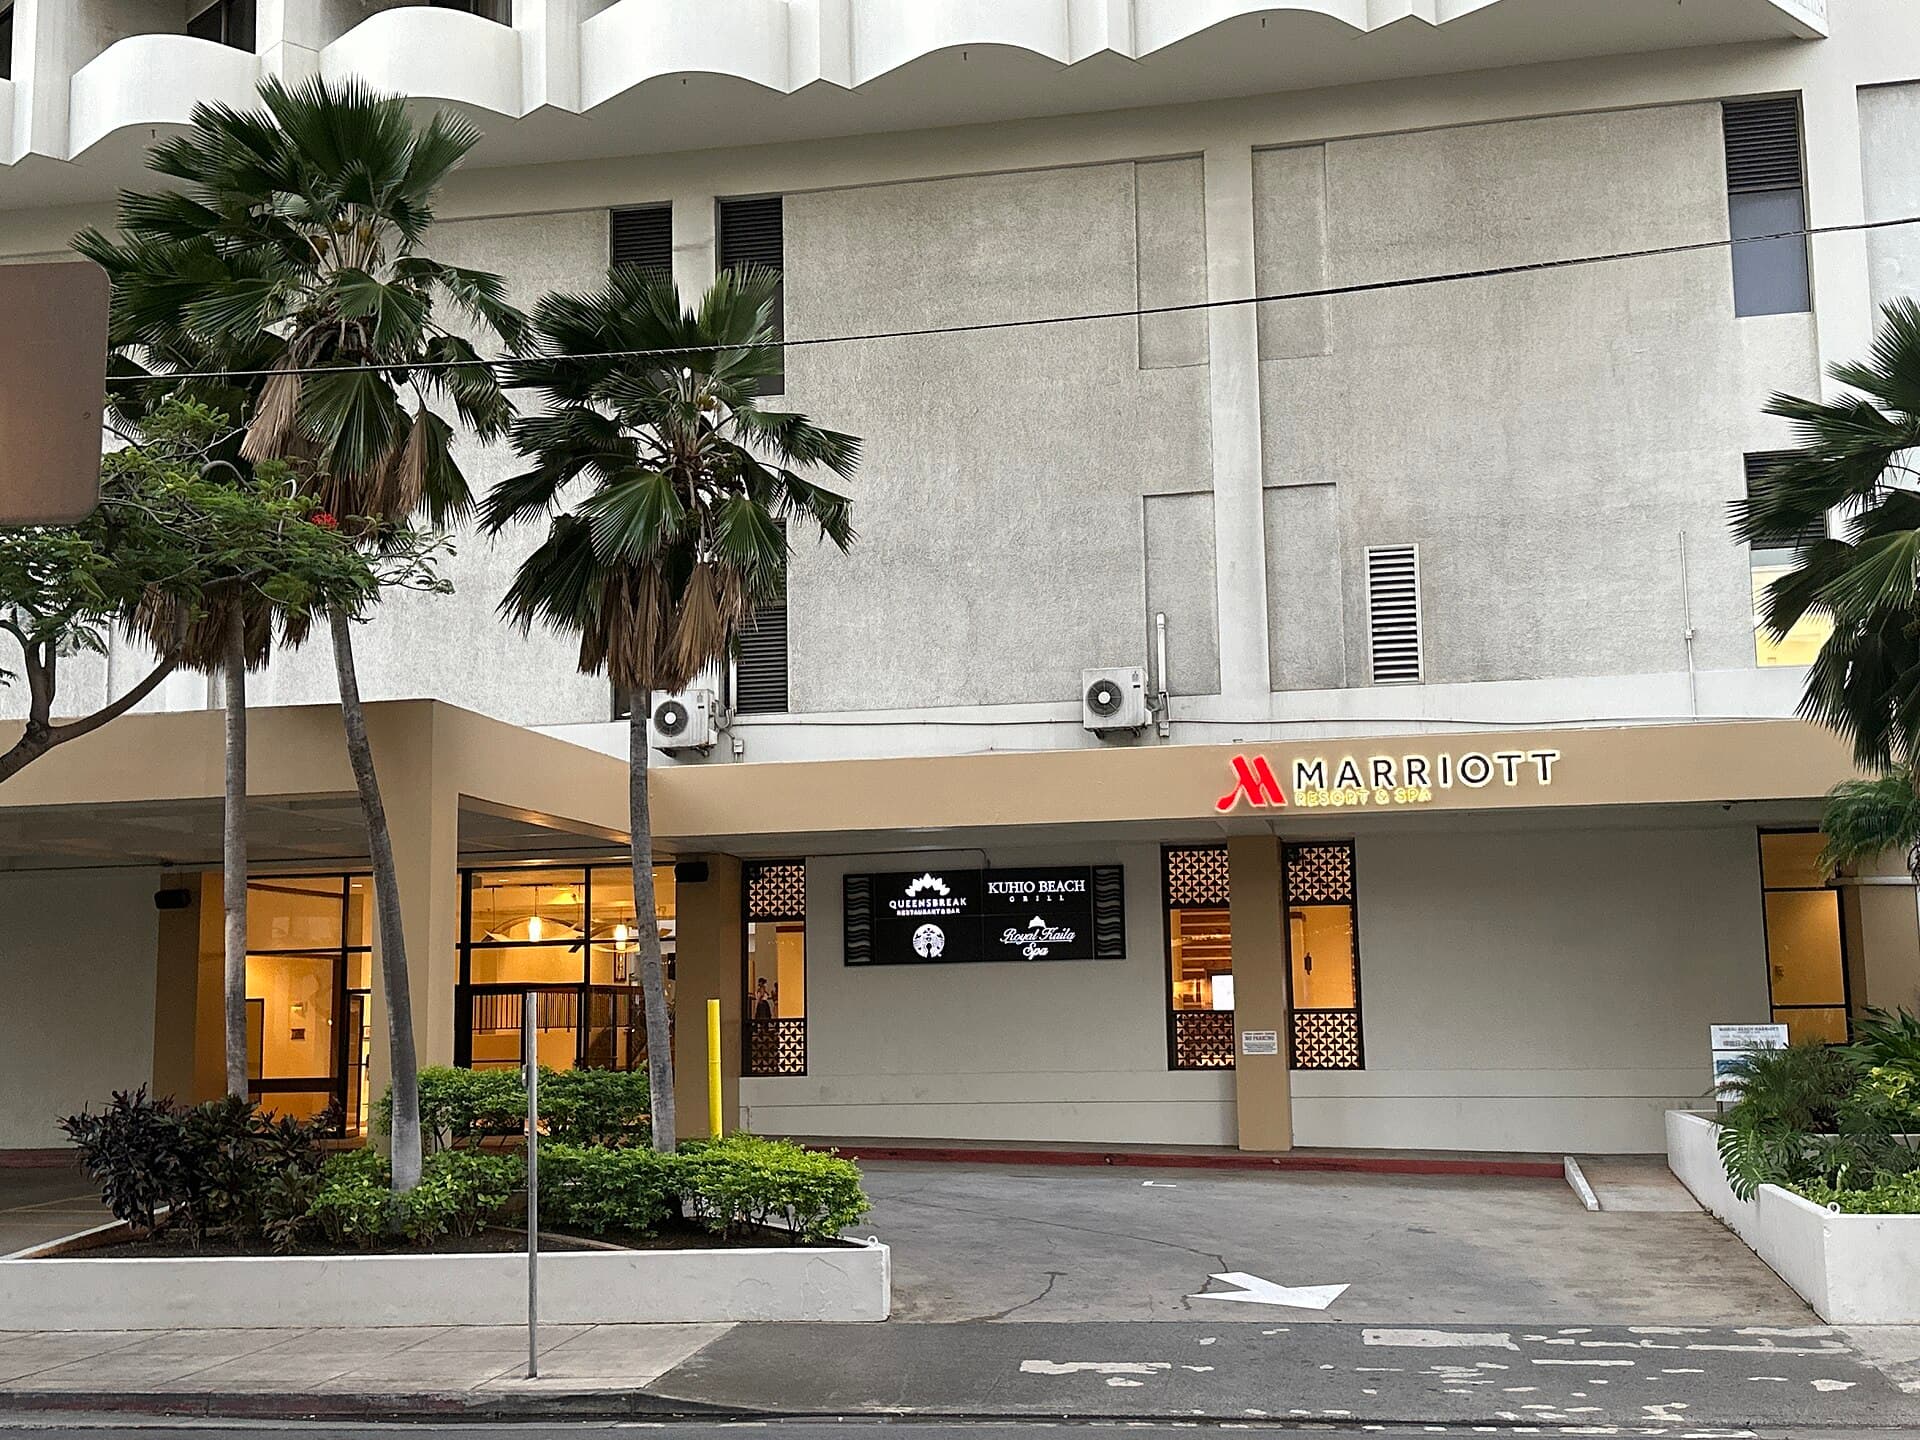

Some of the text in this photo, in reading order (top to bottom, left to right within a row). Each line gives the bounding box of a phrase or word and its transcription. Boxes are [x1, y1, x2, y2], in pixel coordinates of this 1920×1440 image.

[1295, 752, 1558, 789] MARRIOTT
[1294, 787, 1432, 807] RESORT & SPA
[988, 880, 1086, 894] KUHIO BEACH
[888, 897, 967, 910] QUEENSBREAK
[1000, 928, 1040, 945] Royal
[1023, 941, 1049, 961] Spa
